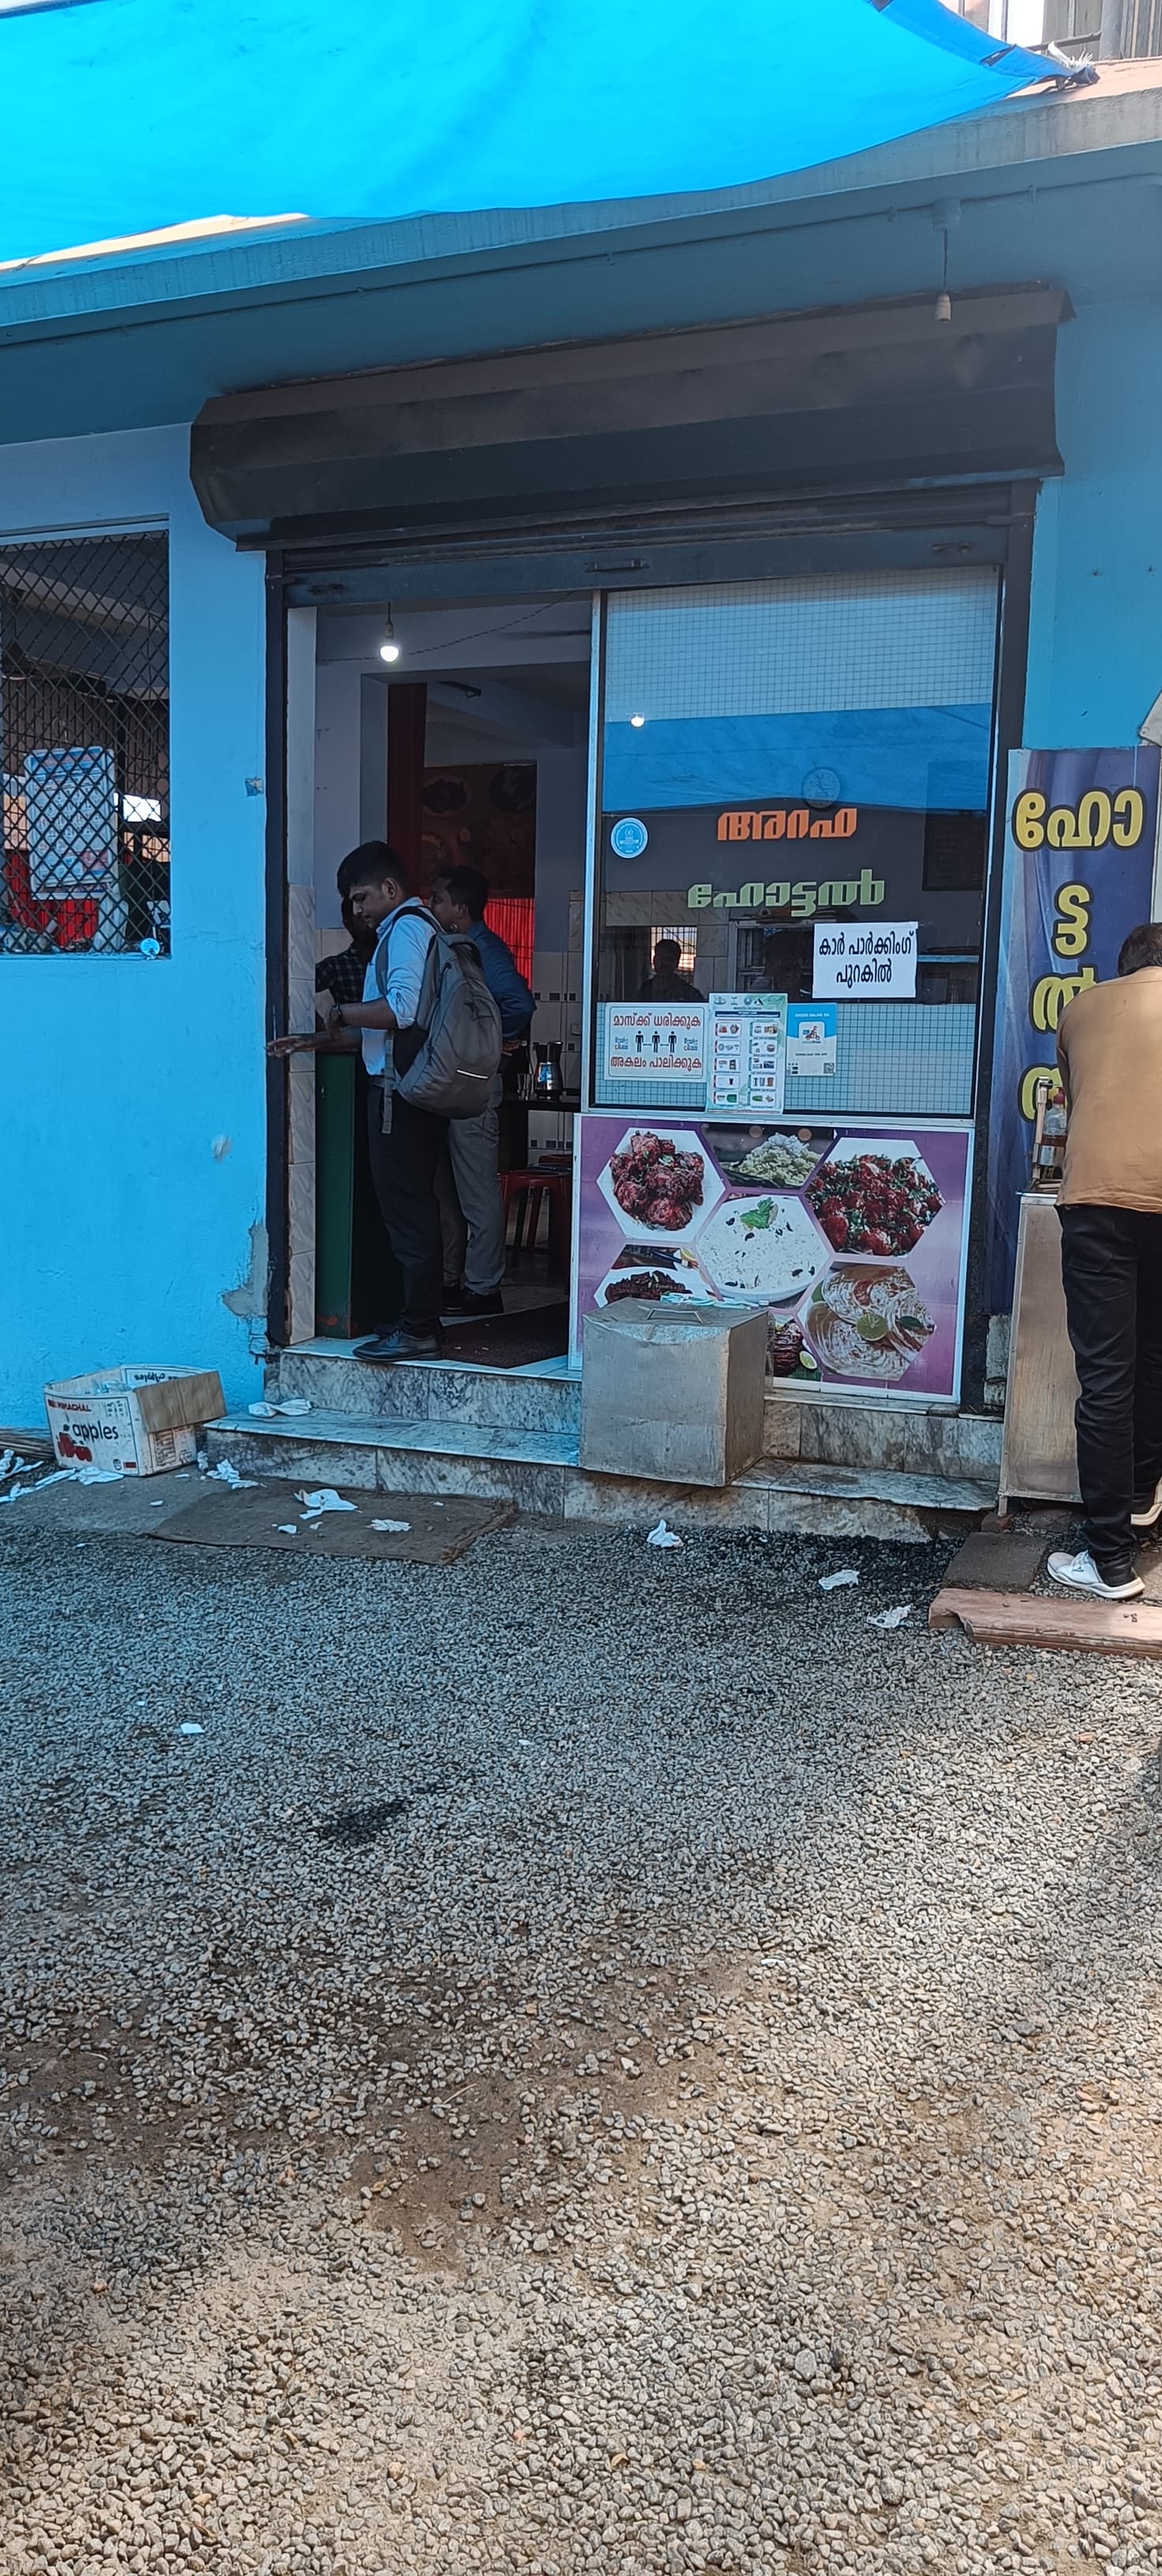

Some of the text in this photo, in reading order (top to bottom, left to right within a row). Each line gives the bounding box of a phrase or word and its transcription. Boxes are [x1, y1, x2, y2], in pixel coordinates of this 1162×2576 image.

[717, 807, 858, 841] അറഫ
[688, 869, 885, 917] ഹോട്ടൽ
[819, 930, 914, 955] കാർ പാർക്കിംഗ്
[836, 957, 892, 989] പുറകിൽ
[654, 1013, 701, 1030] ധരിക്കുക
[610, 1054, 703, 1072] അകലം പാലിക്കുക
[72, 1421, 119, 1443] apples
